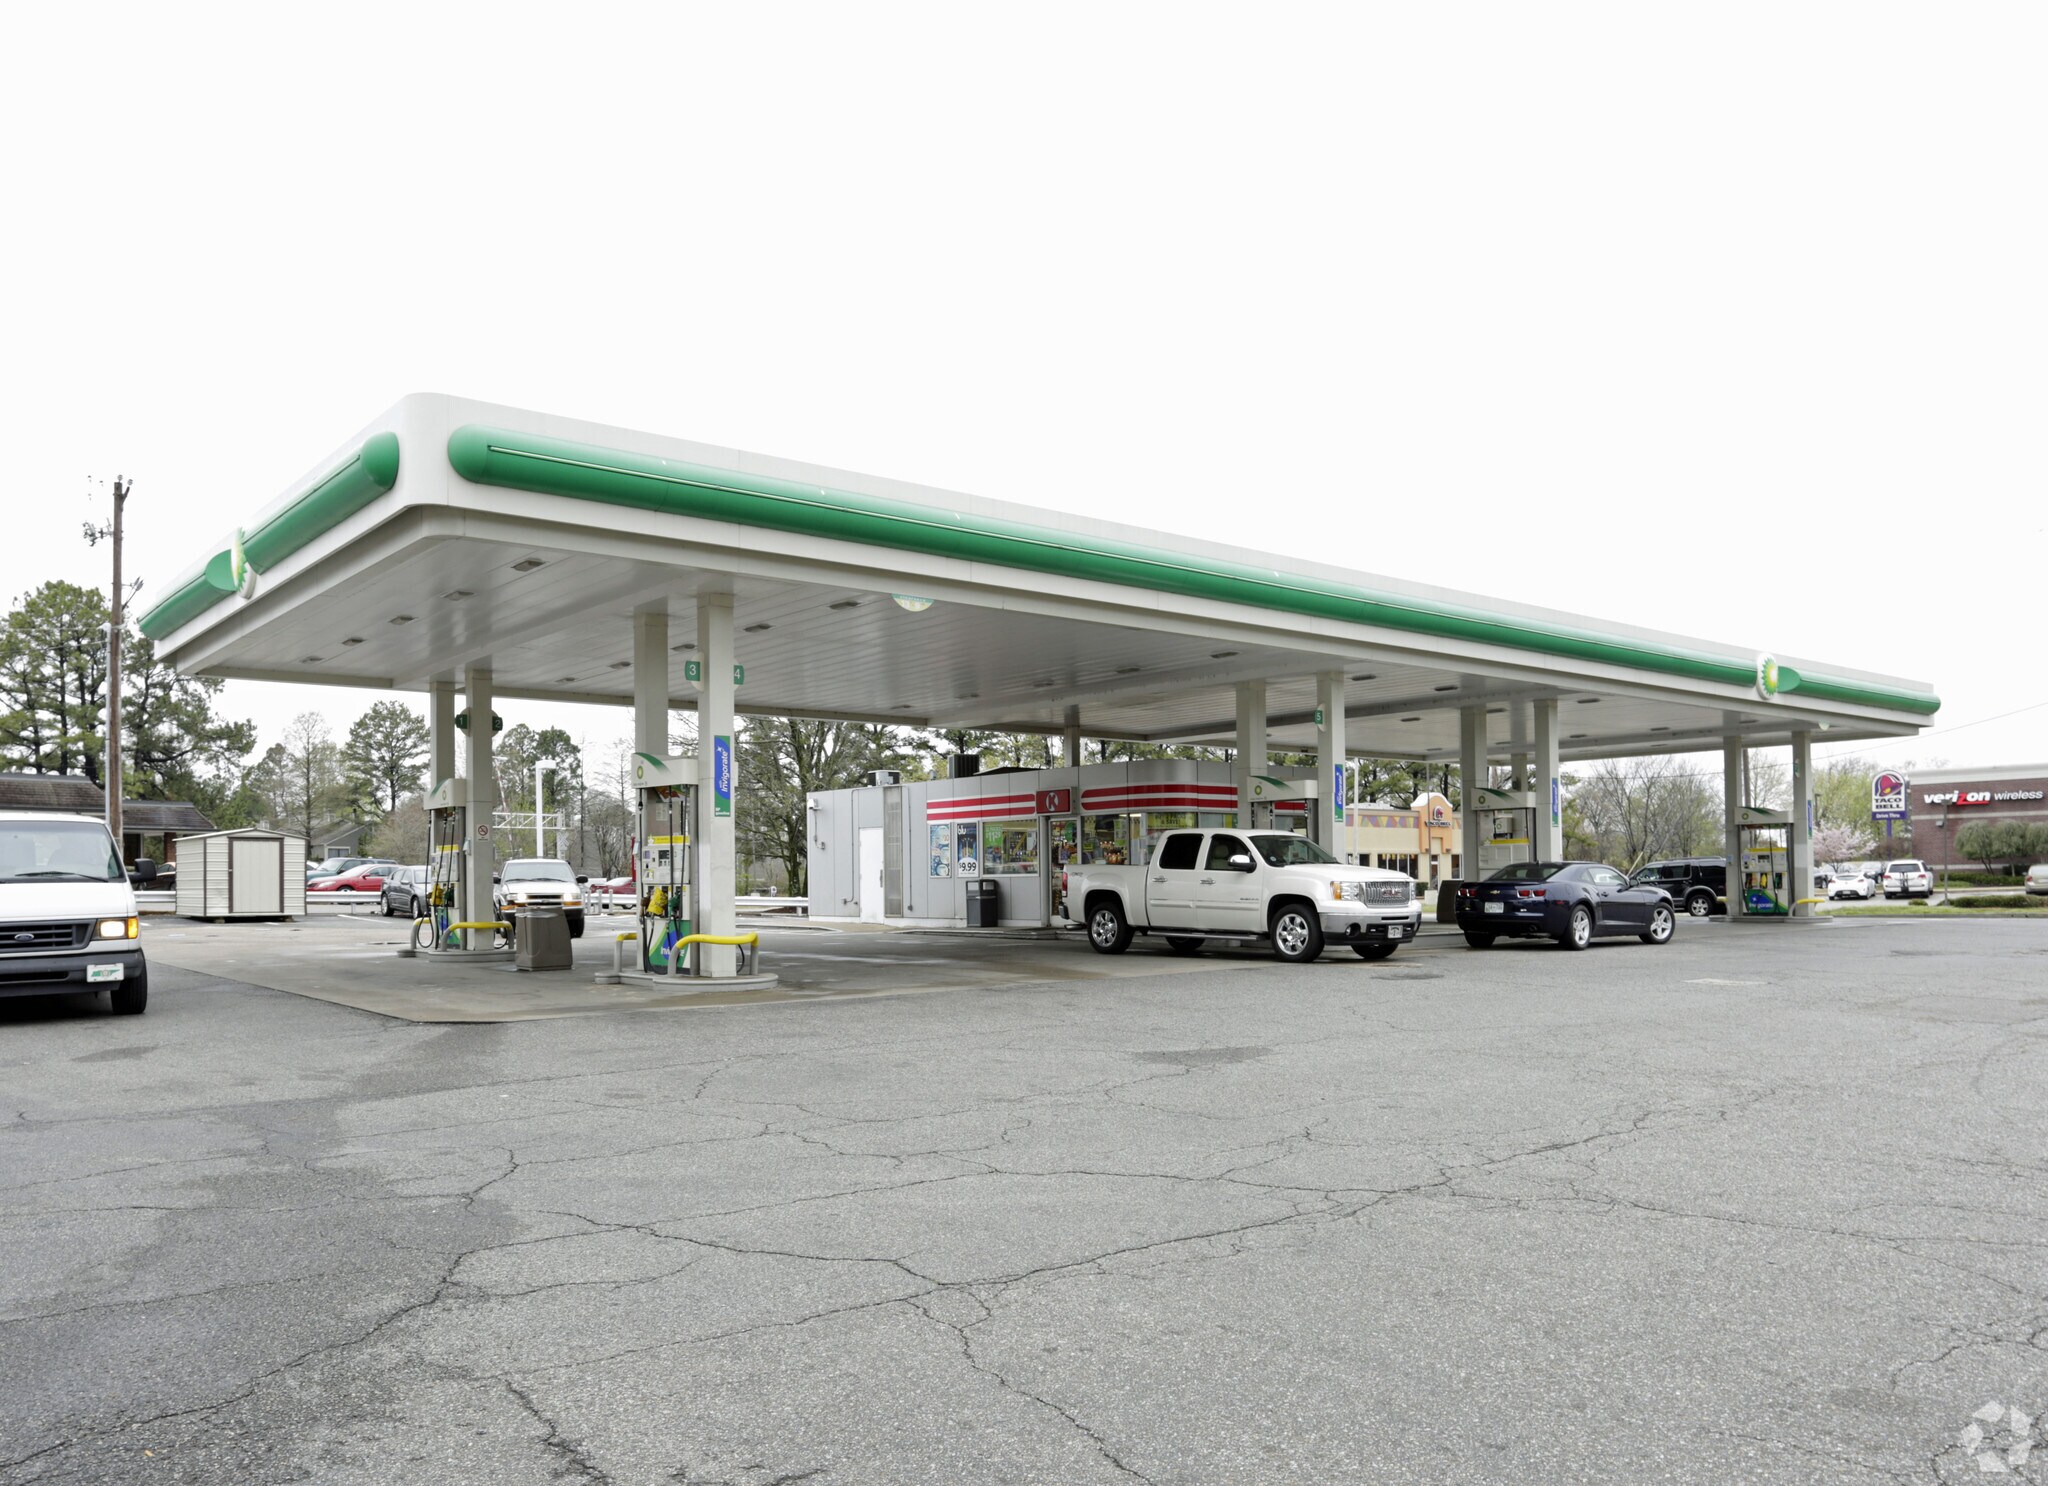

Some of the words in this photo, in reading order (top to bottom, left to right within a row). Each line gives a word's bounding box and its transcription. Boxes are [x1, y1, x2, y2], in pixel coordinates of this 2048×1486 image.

[689, 664, 697, 676] 3
[734, 669, 741, 679] 4
[1316, 712, 1321, 720] 5
[495, 720, 501, 728] 2
[721, 752, 729, 792] Invigorate
[1046, 792, 1059, 812] K
[1923, 790, 1991, 805] verizon
[1994, 790, 2044, 800] wireless
[957, 825, 967, 835] blu
[959, 862, 977, 872] $9.99
